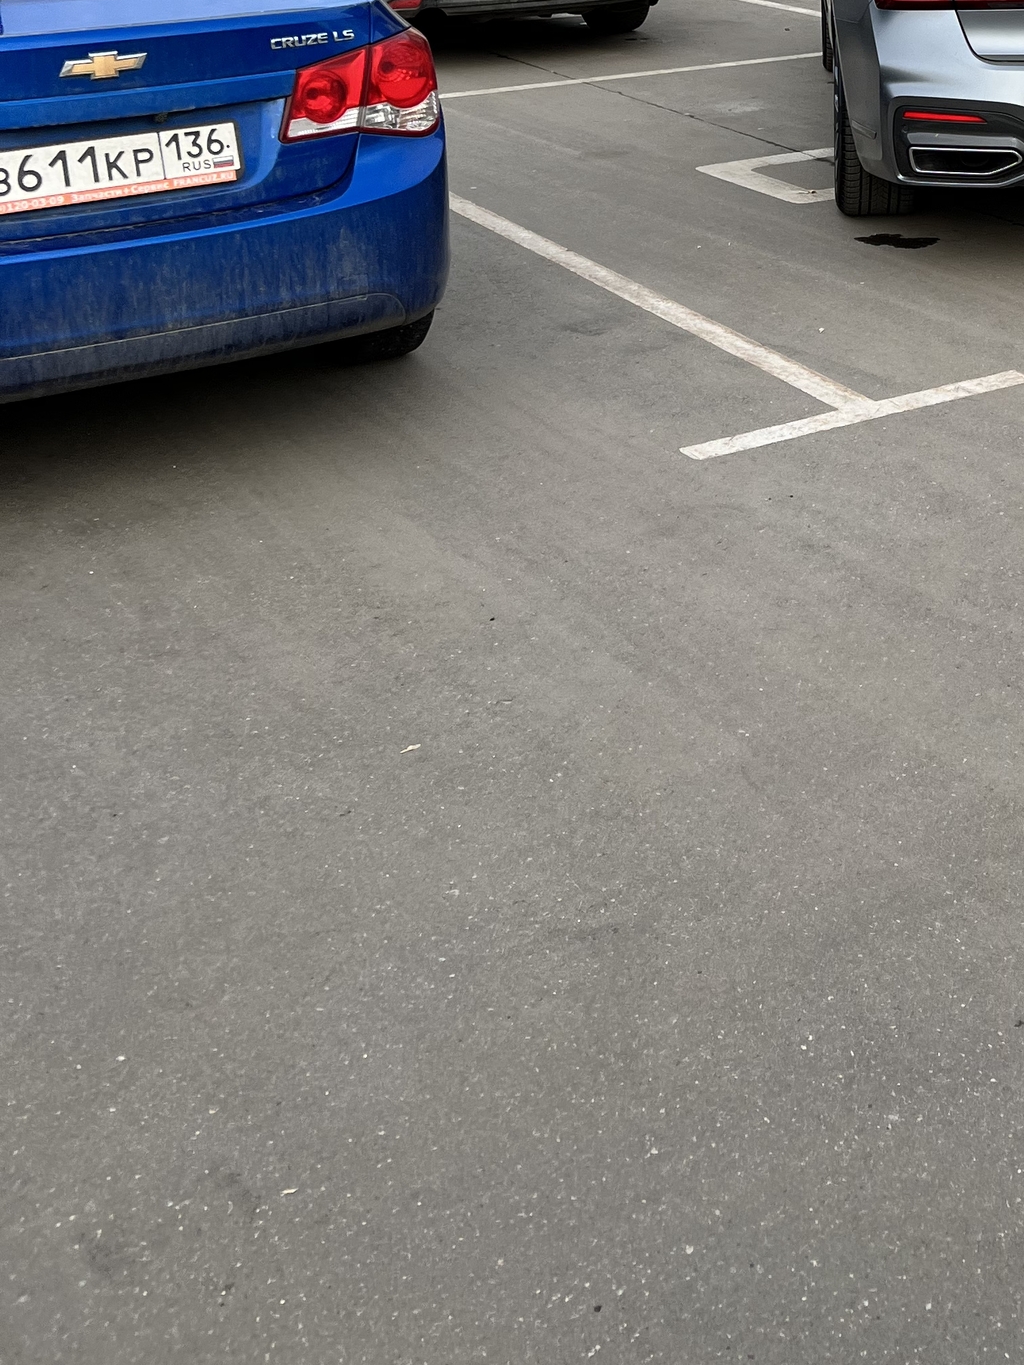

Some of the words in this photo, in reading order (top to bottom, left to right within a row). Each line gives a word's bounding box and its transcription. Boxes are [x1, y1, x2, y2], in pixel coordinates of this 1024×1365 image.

[270, 32, 328, 49] CRUZE
[332, 29, 355, 42] LS
[165, 128, 225, 161] 136
[182, 159, 212, 172] RUS
[173, 171, 234, 187] FRANCUZ.RU
